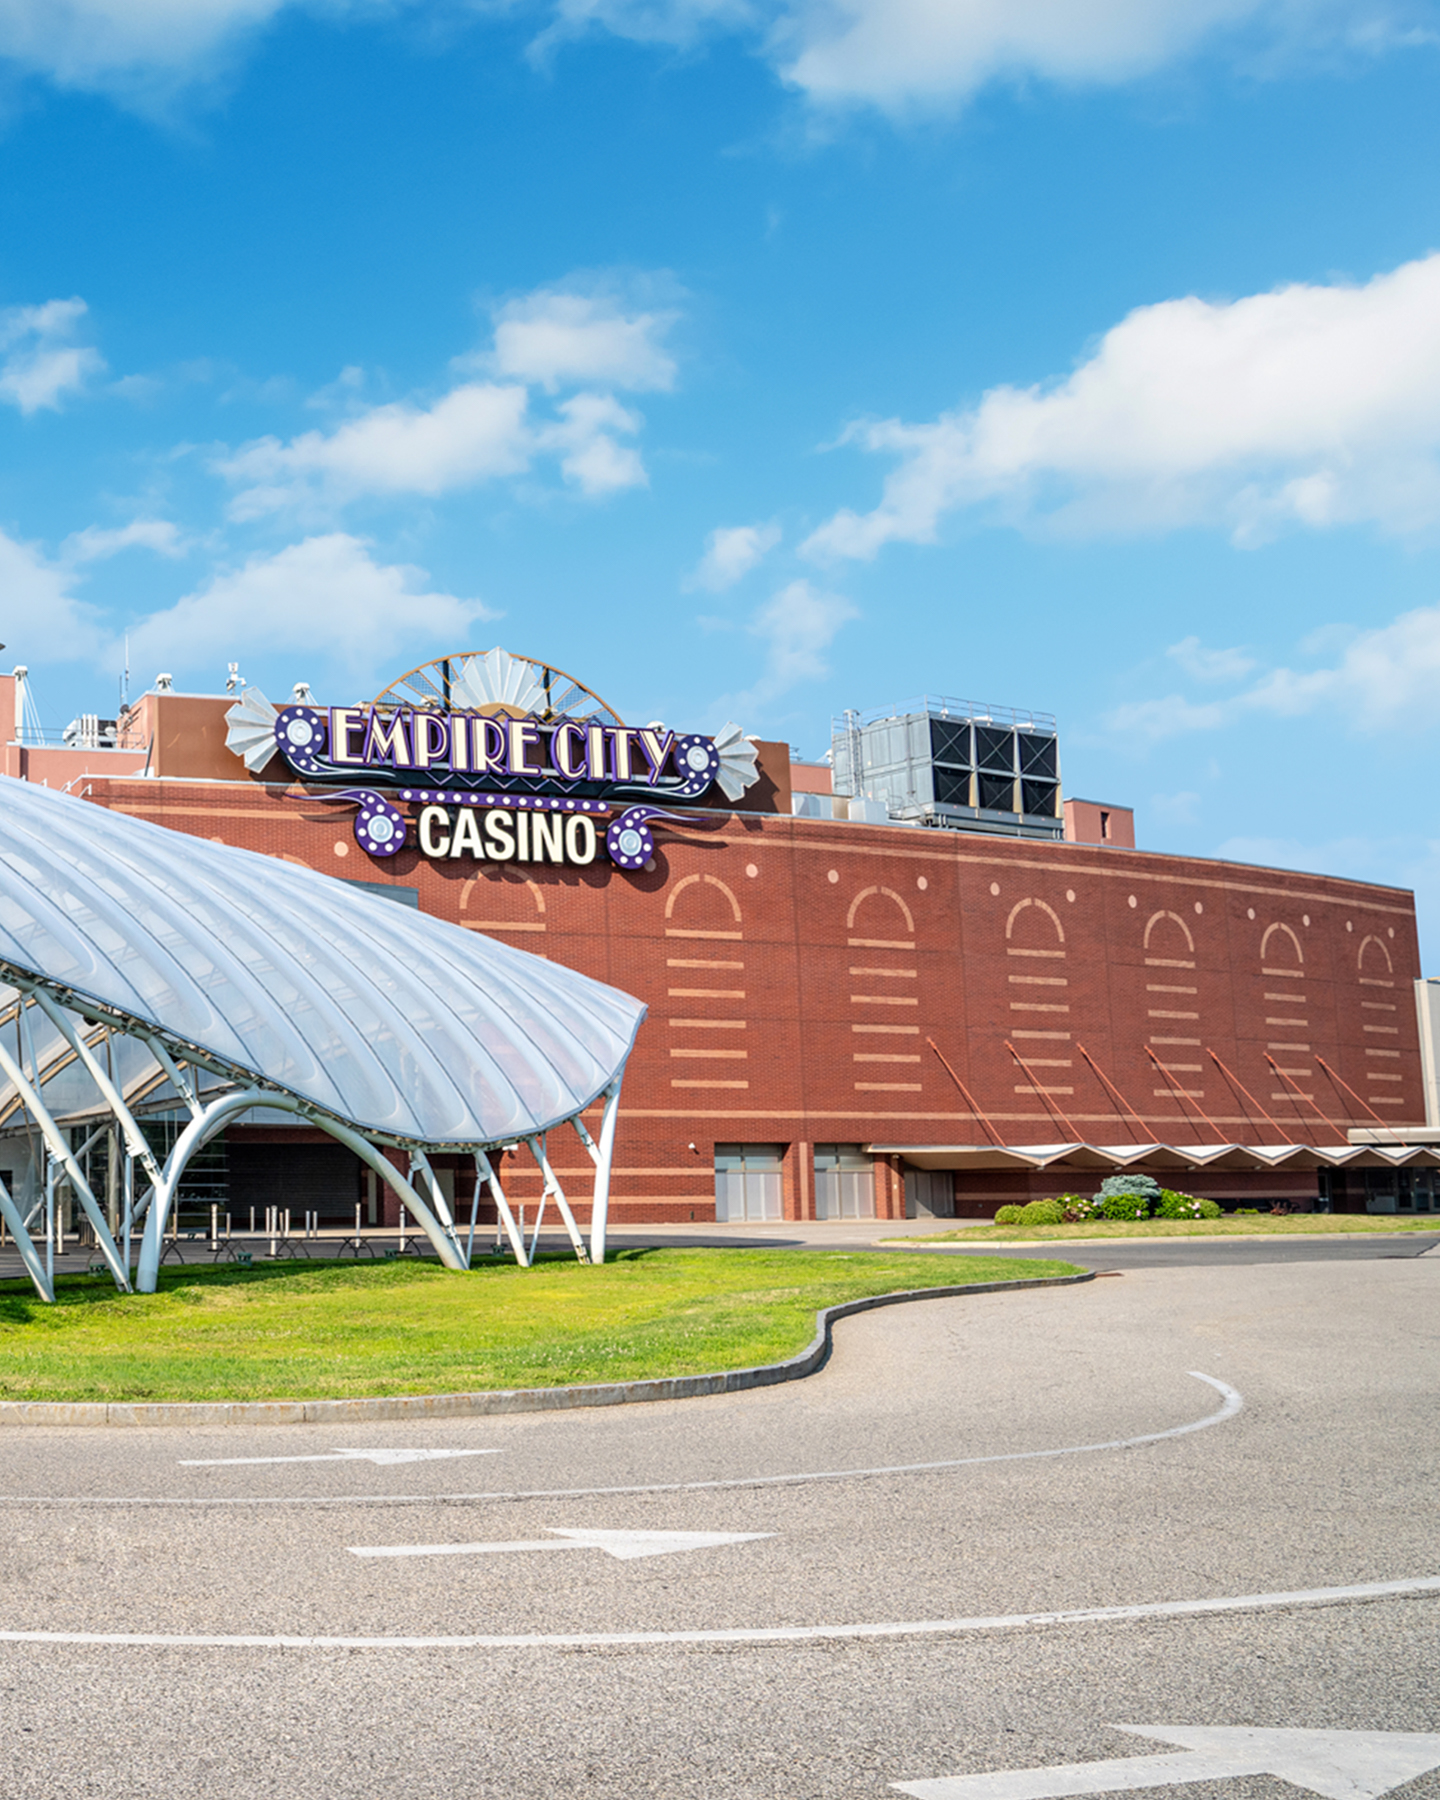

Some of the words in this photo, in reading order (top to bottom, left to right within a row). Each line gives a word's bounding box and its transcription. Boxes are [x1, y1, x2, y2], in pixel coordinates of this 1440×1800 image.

[327, 705, 542, 778] EMPIRE
[550, 723, 676, 787] CITY
[417, 804, 597, 867] CASINO
